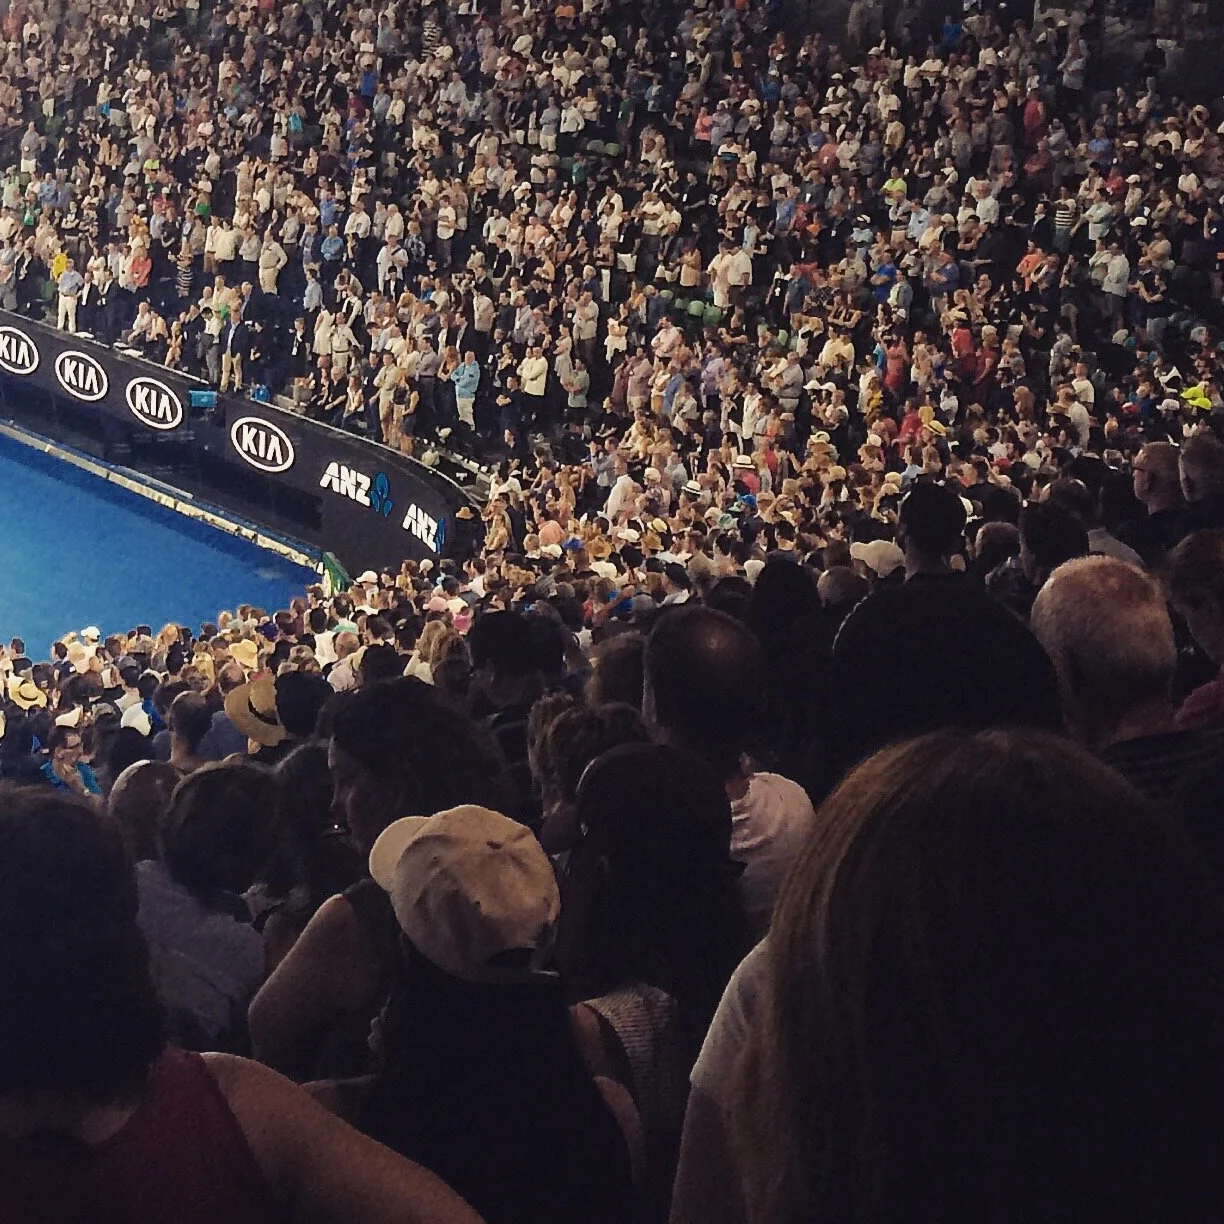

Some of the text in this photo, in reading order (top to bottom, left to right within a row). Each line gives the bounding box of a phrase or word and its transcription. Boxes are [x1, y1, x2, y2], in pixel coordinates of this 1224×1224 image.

[64, 358, 99, 394] KIA
[135, 384, 173, 422] KIA
[242, 424, 283, 465] KIA
[319, 462, 371, 507] ANZ
[402, 503, 438, 553] ANZ
